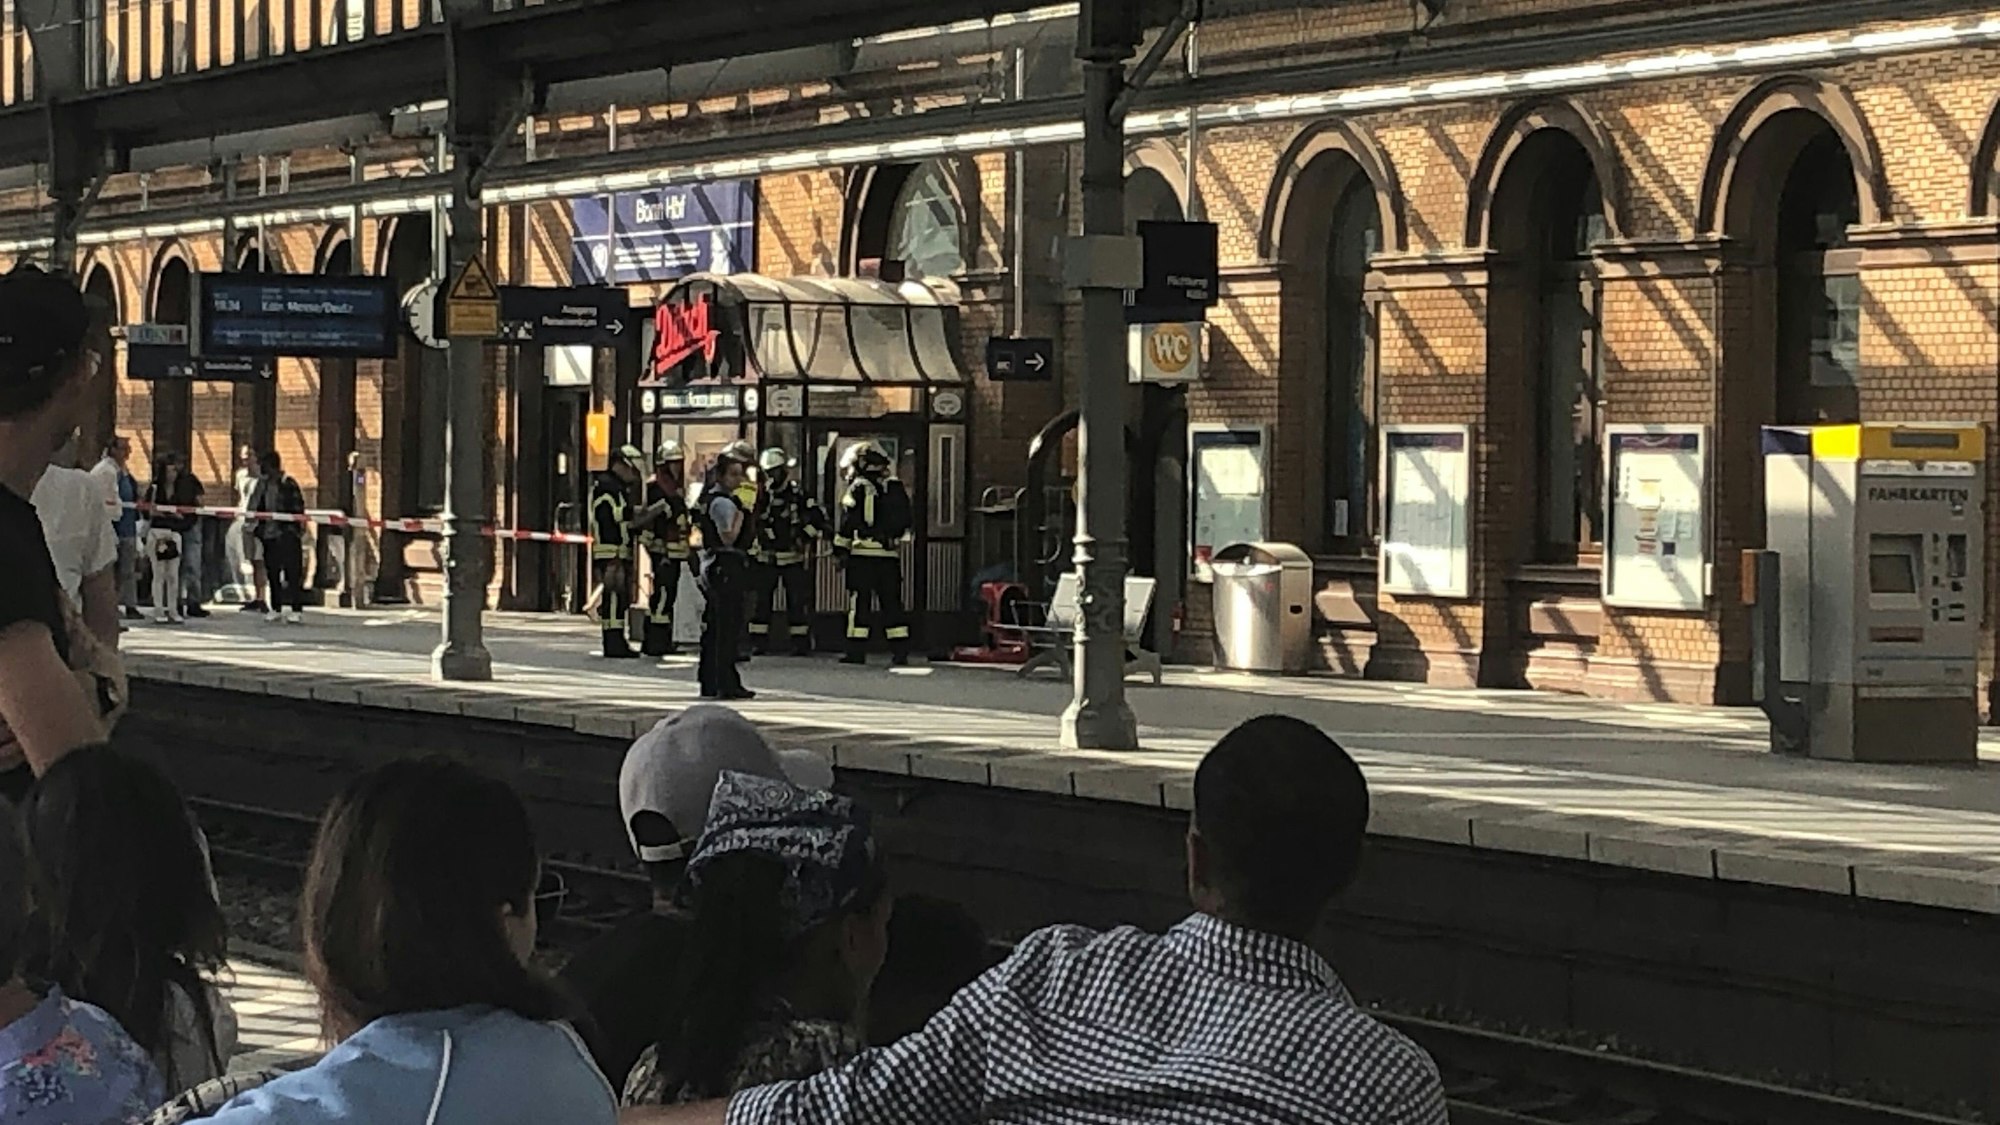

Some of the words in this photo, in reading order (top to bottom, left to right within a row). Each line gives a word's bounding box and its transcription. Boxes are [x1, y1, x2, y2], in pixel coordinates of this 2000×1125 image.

[636, 198, 664, 224] Bonn
[665, 194, 687, 220] Hbf
[1153, 333, 1188, 363] WC
[1868, 486, 1969, 502] FAHRKARTEN
